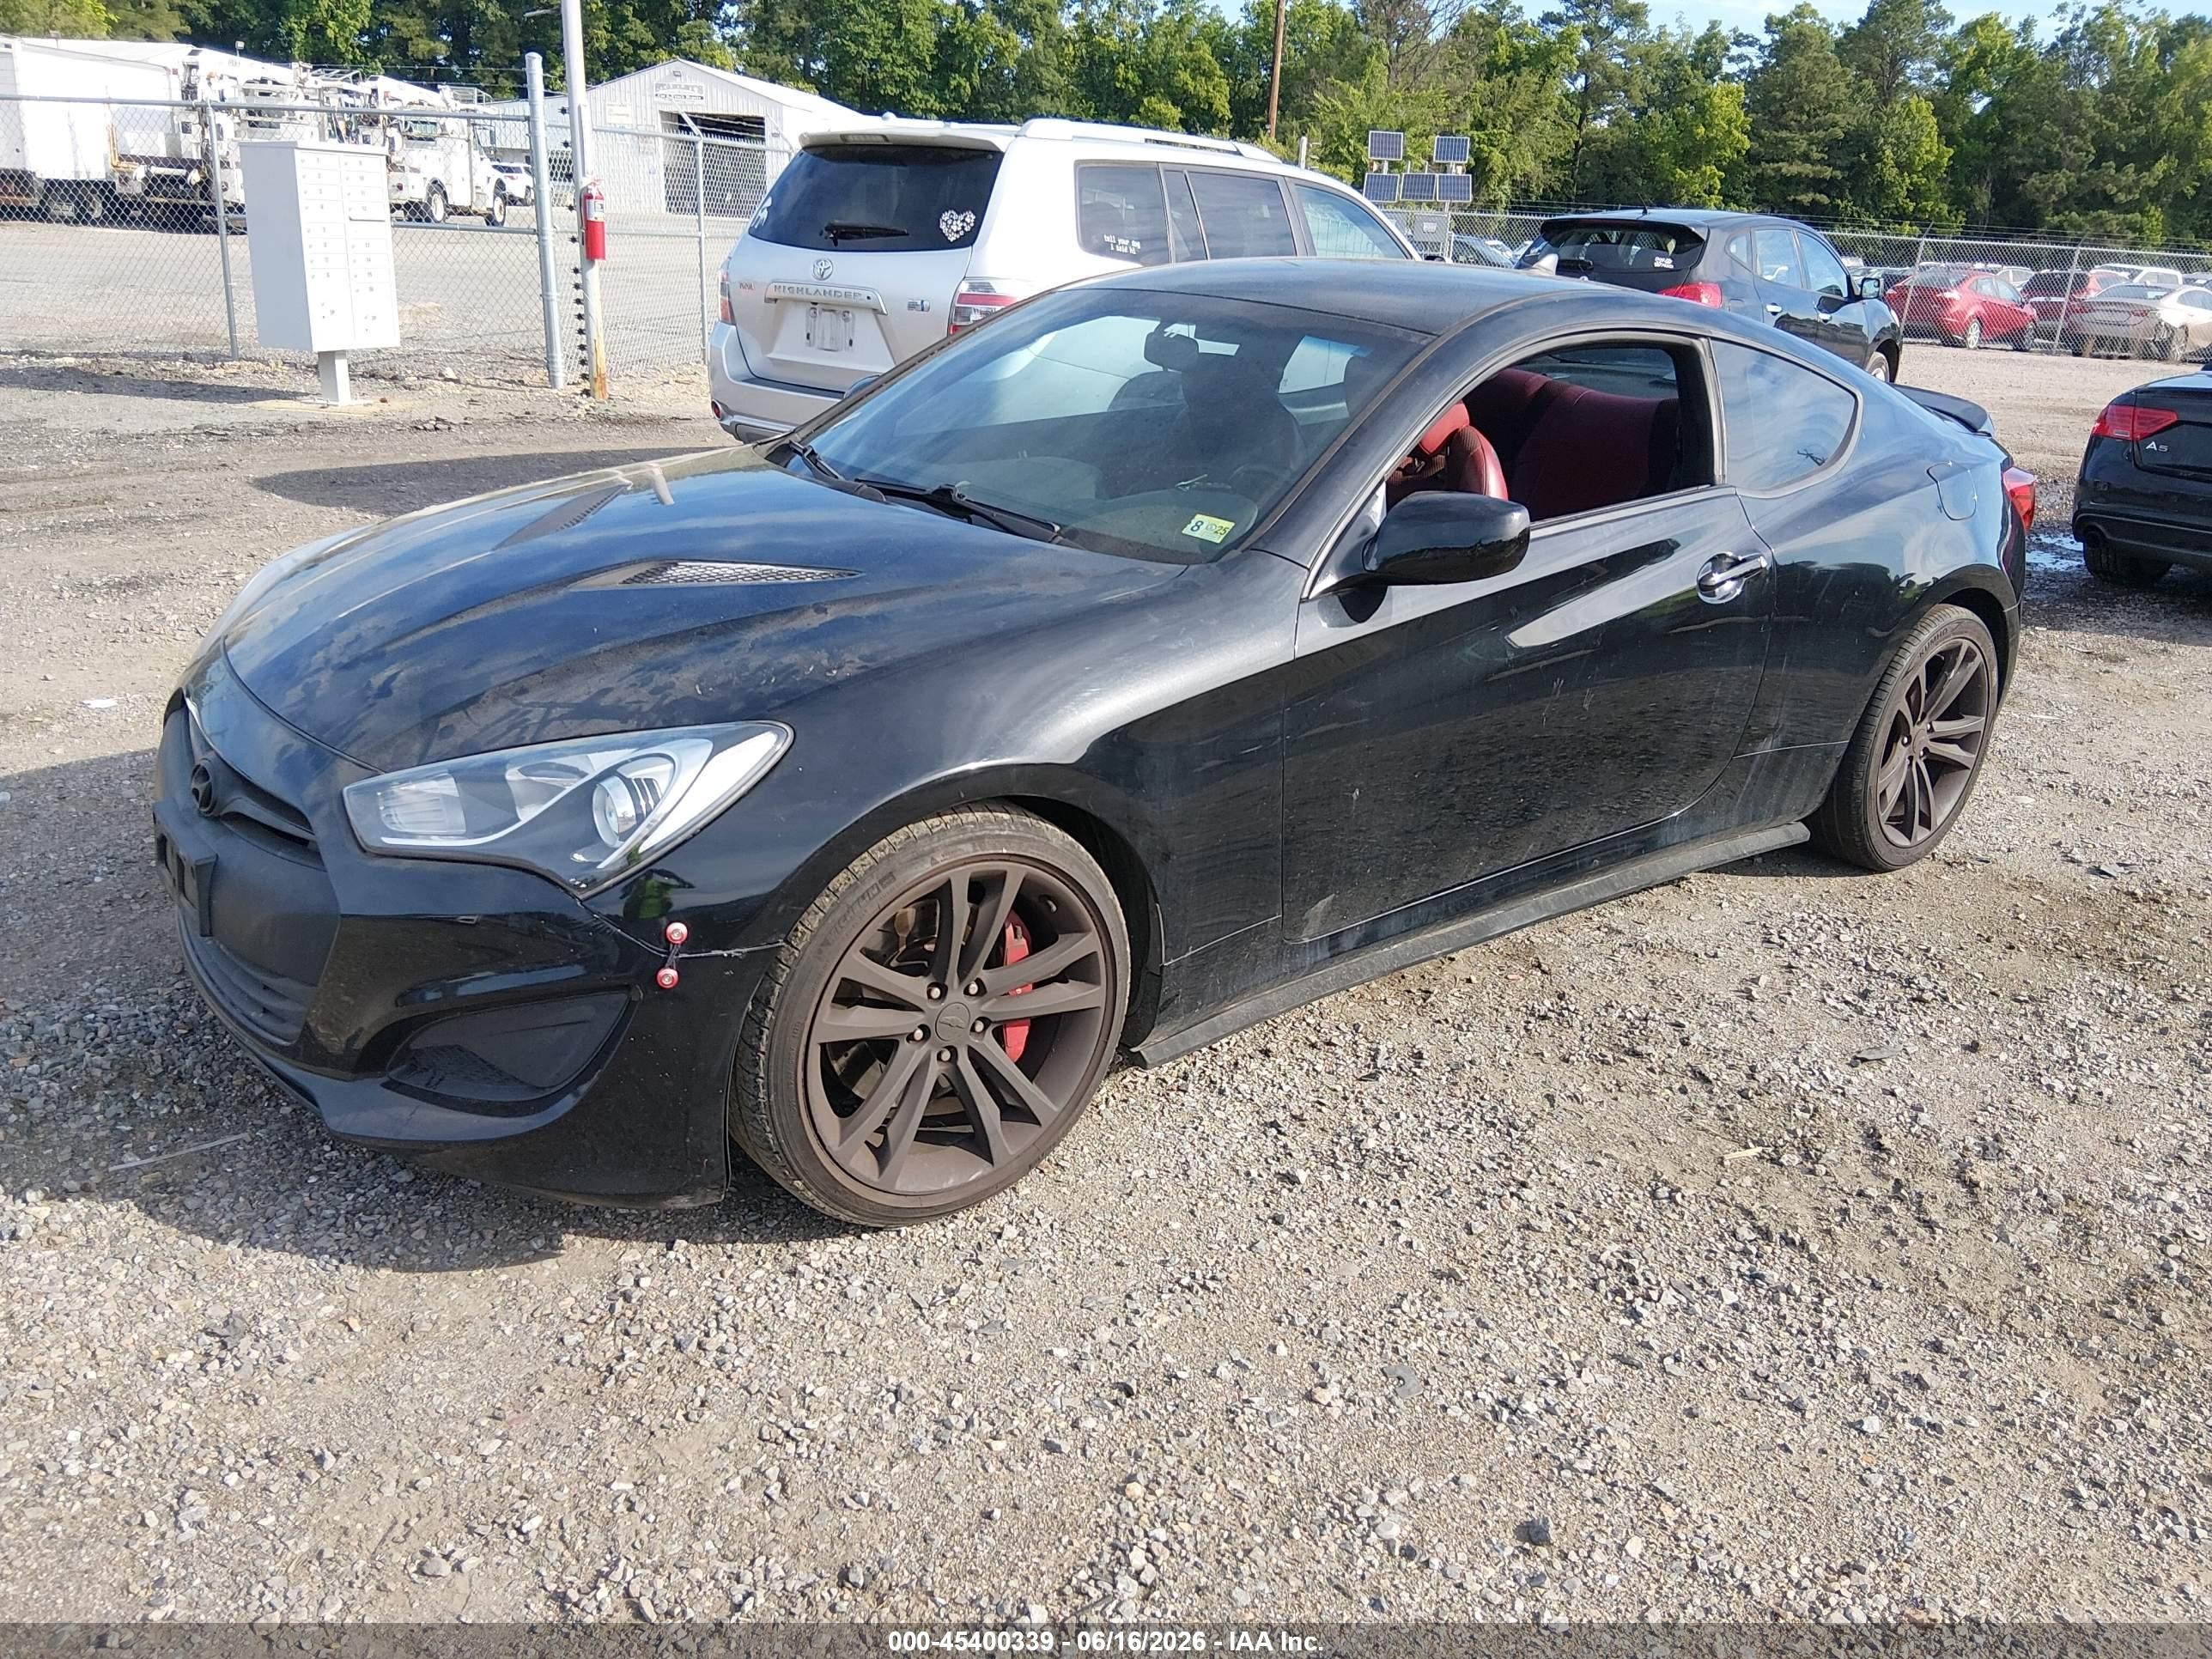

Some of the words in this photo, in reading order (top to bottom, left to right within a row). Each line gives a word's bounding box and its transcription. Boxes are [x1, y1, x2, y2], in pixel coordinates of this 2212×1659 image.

[774, 284, 862, 300] HIGHLANDER
[2146, 441, 2168, 452] A5
[1190, 520, 1204, 532] 8
[1214, 526, 1229, 535] 25
